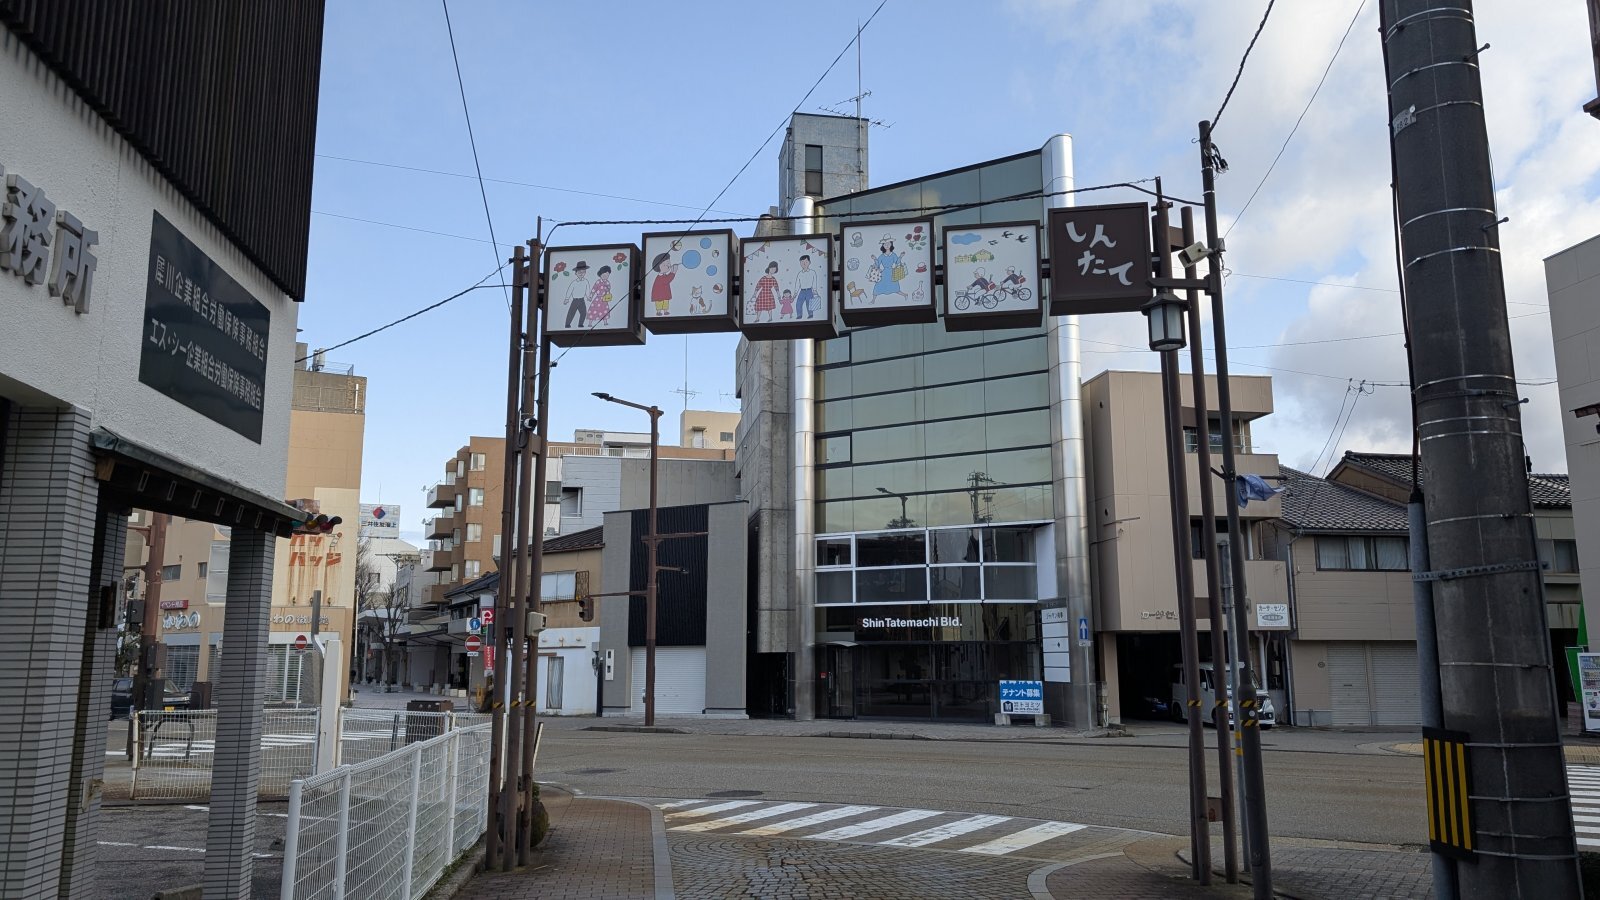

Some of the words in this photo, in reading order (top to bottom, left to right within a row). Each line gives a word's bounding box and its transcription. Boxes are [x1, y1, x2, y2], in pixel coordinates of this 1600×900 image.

[0, 163, 99, 314] 務所
[1066, 221, 1116, 248] しん
[1077, 250, 1134, 286] たて
[155, 255, 265, 362] 犀川企業組合労働保険事務組合
[862, 617, 885, 628] Shin
[885, 616, 939, 628] Tatemachi
[940, 616, 963, 627] Bld.
[1002, 688, 1041, 698] テナント募集
